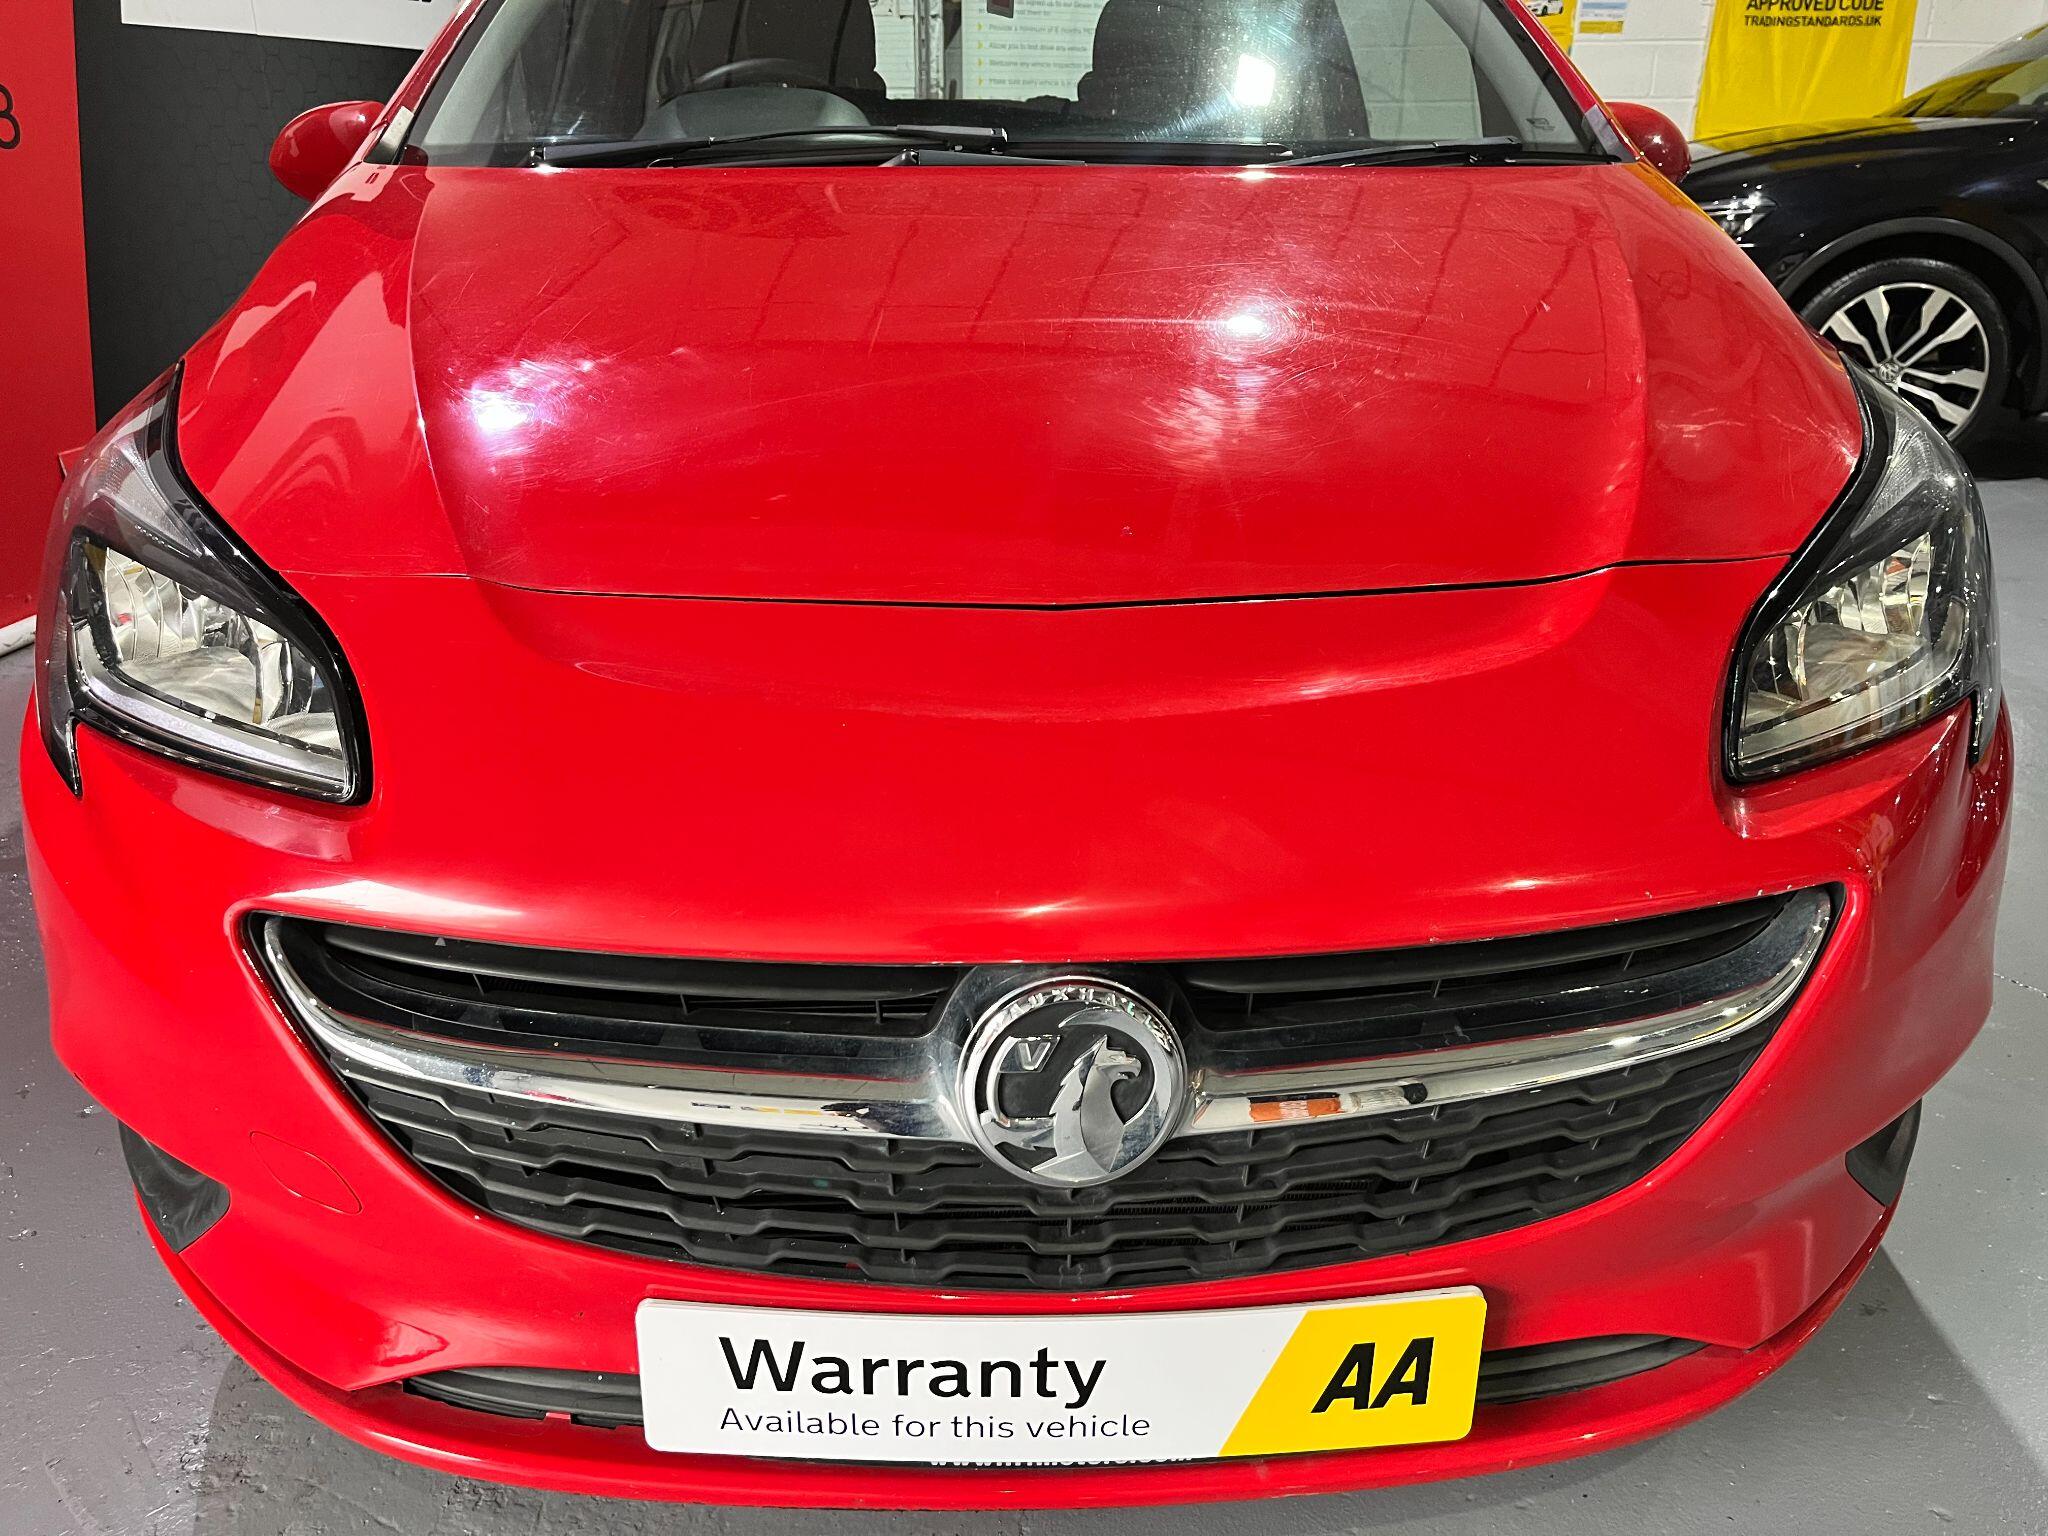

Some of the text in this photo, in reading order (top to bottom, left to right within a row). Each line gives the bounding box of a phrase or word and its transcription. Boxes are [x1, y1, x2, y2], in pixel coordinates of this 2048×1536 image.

[1746, 0, 1884, 11] APPROVED CODE
[1744, 15, 1882, 27] TRADINGSTANDARDS.UK
[718, 1336, 1107, 1409] Warranty
[1310, 1336, 1435, 1413] AA
[720, 1408, 1150, 1438] Available for this vehicle
